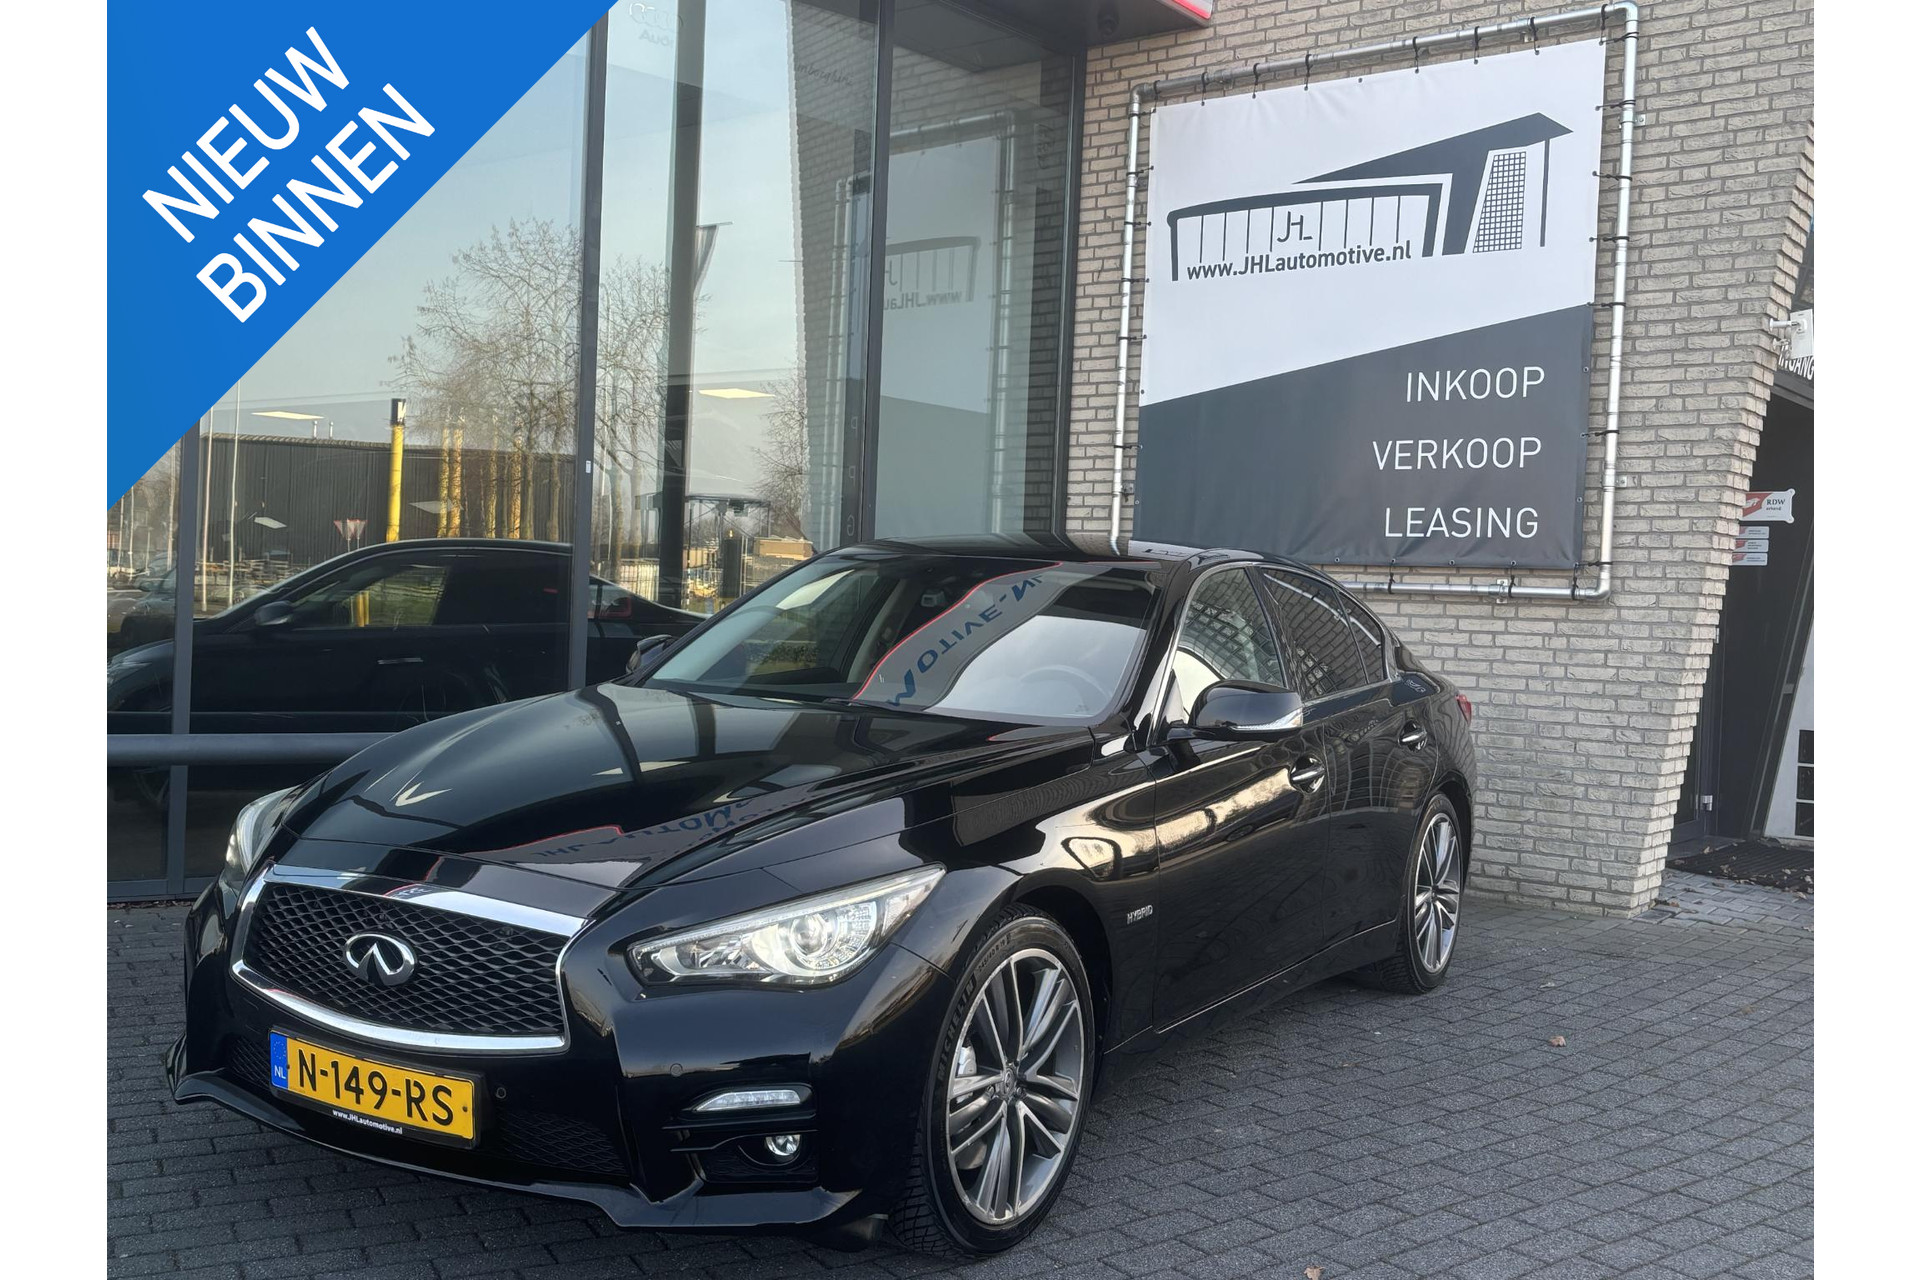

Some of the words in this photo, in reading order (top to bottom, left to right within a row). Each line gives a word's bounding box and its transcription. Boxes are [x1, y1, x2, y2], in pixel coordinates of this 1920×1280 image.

[1187, 240, 1411, 280] www.JHLautomotive.nl
[1406, 366, 1545, 402] INKOOP
[1372, 437, 1543, 470] VERKOOP
[1385, 506, 1539, 539] LEASING
[1127, 905, 1153, 925] HYBRID
[937, 973, 977, 1082] MICHELIN
[274, 1065, 286, 1080] NL
[298, 1048, 454, 1126] N-149-RS
[332, 1109, 403, 1135] www.JHLautomotive.nl
